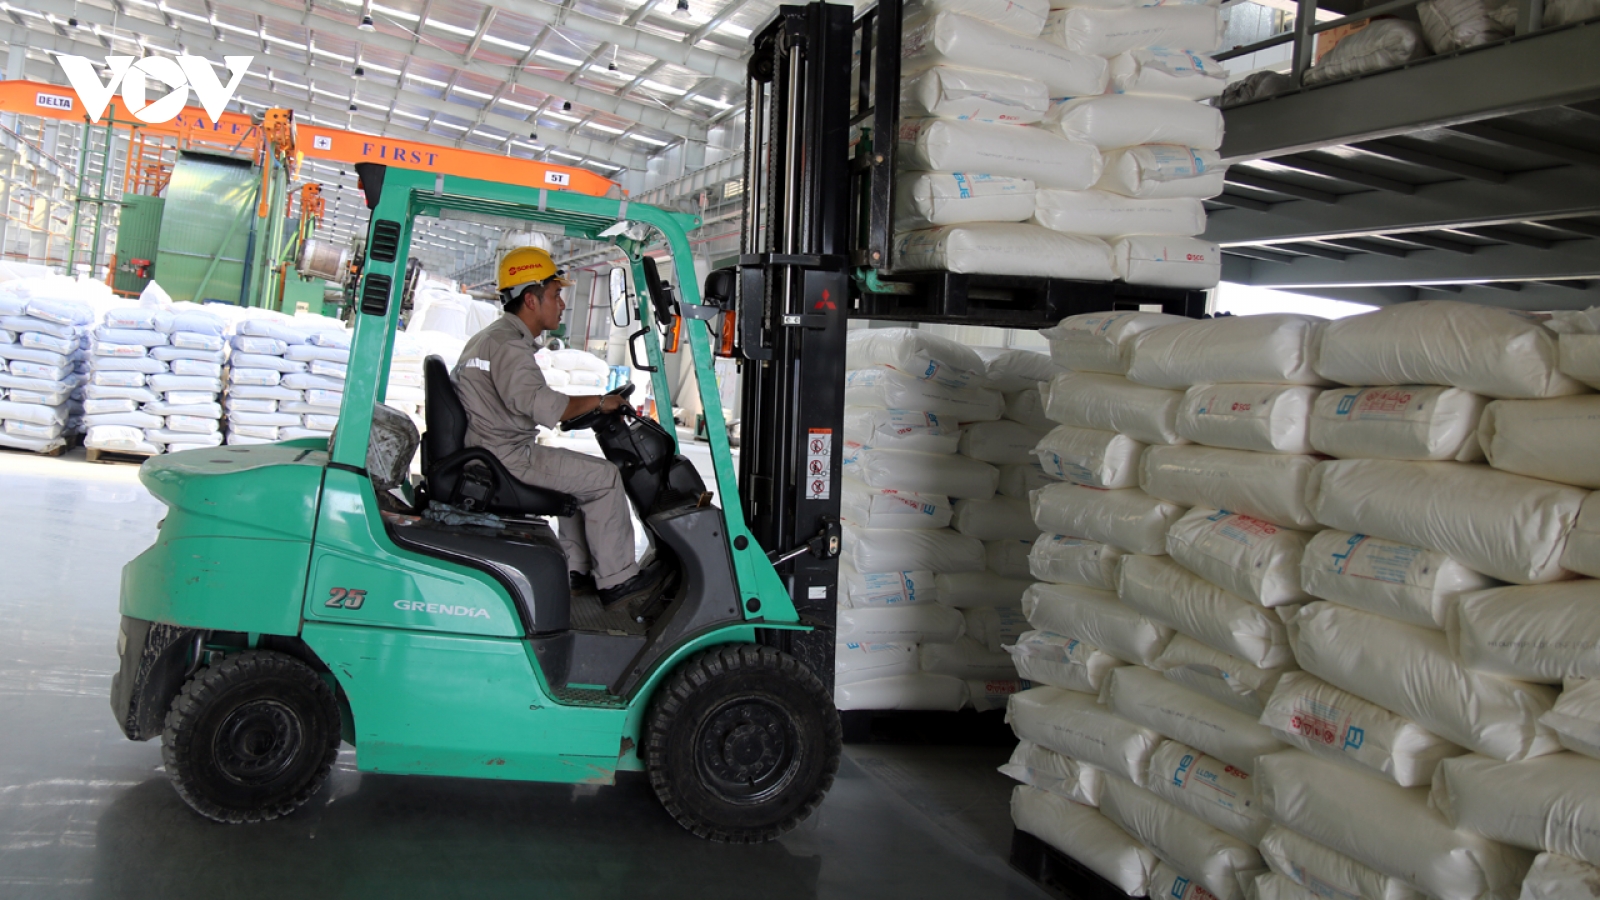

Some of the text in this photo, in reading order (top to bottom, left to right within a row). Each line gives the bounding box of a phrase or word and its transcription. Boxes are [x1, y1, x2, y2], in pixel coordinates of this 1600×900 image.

[38, 95, 71, 109] DELTA
[362, 142, 438, 166] FIRST
[325, 587, 367, 610] 25
